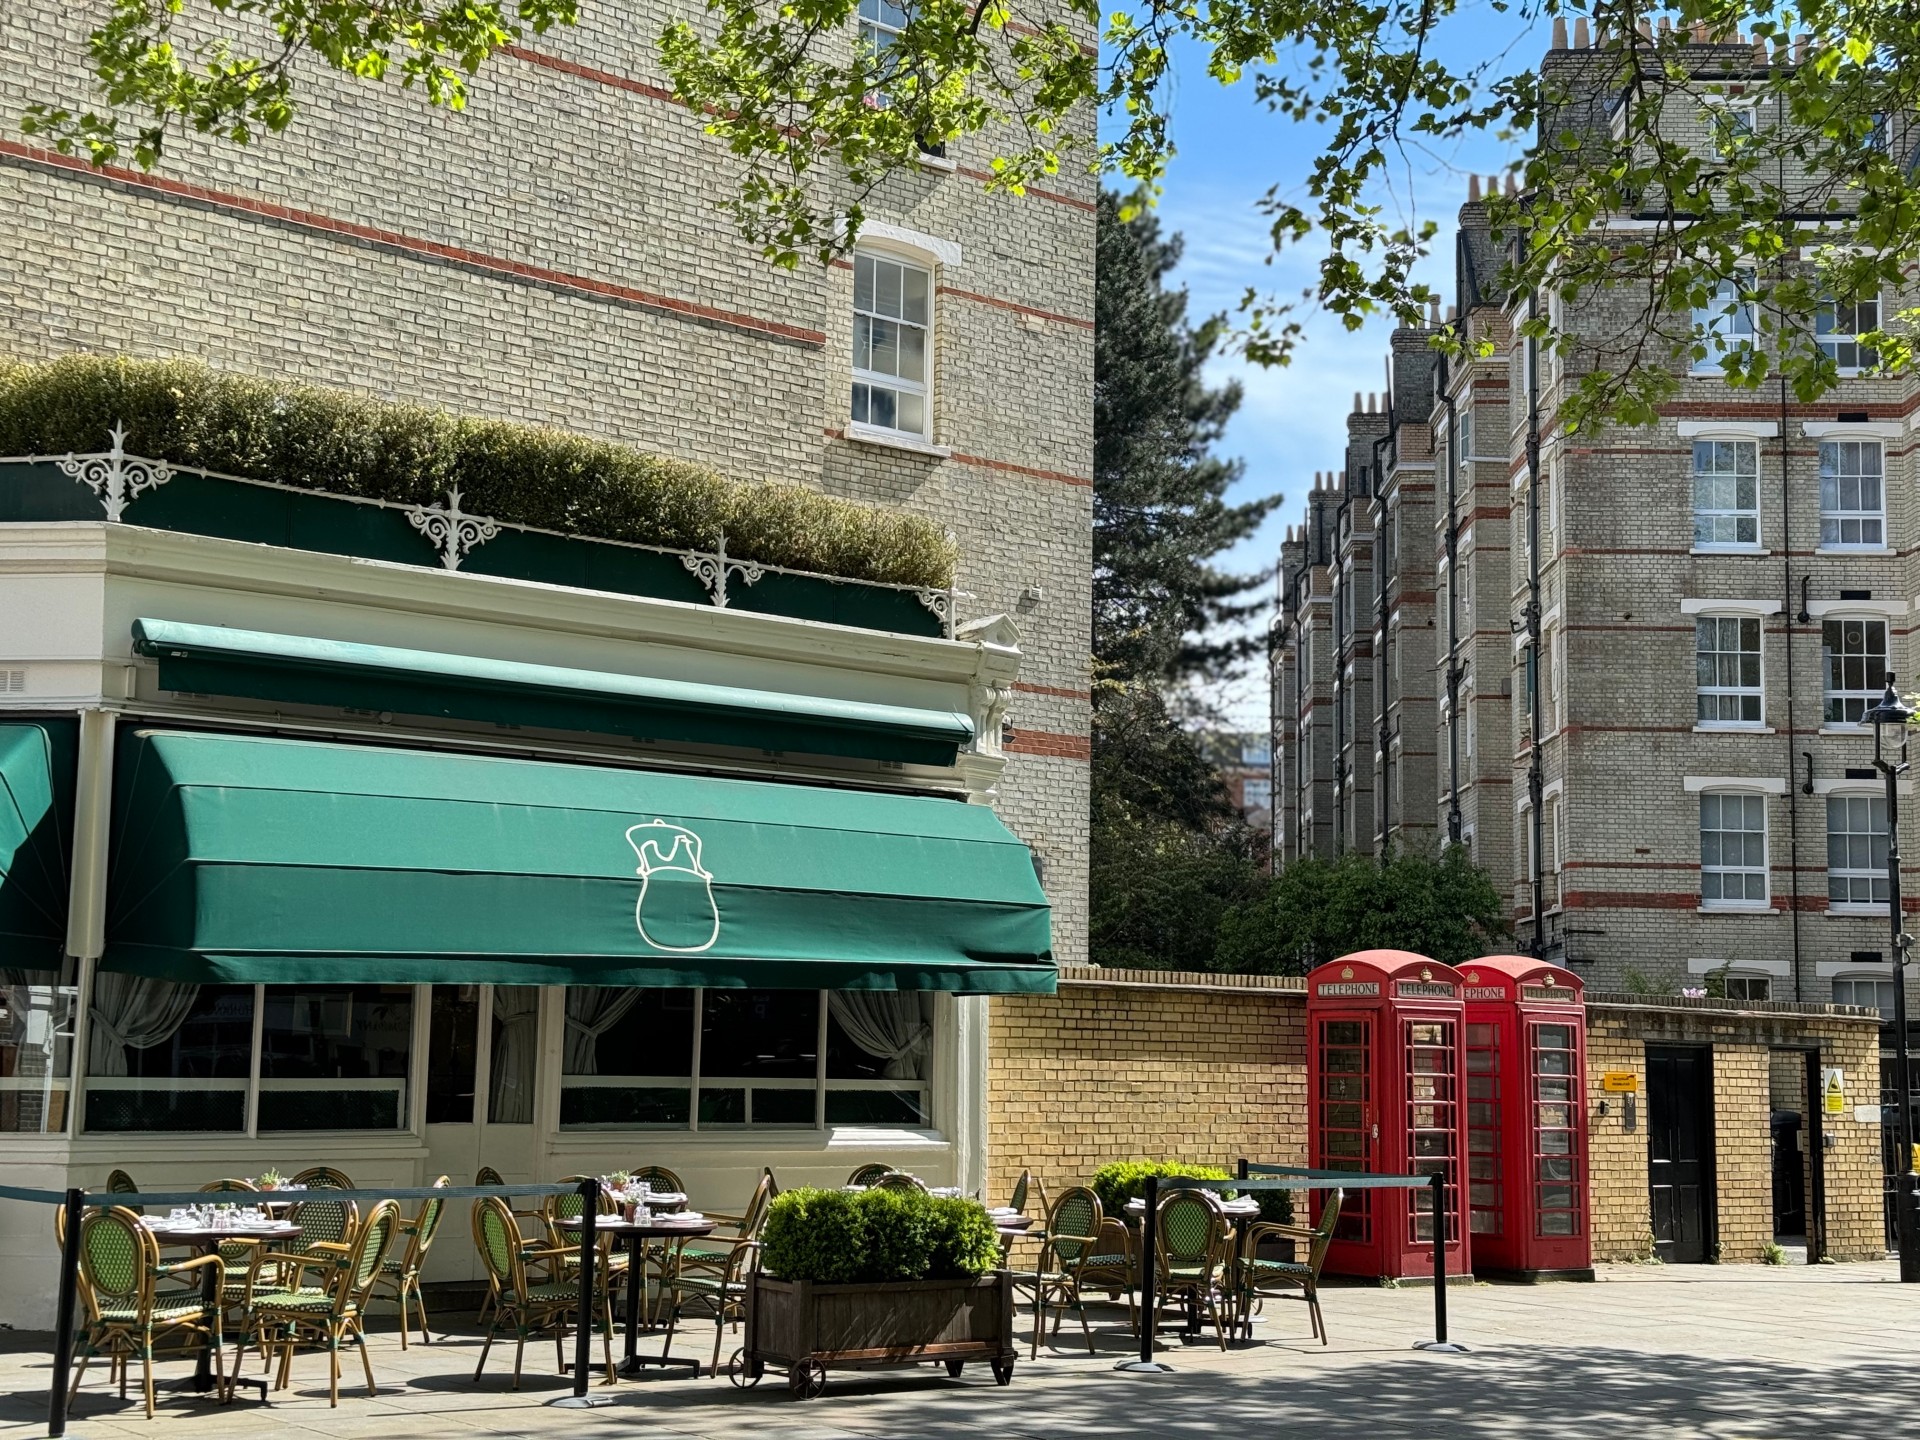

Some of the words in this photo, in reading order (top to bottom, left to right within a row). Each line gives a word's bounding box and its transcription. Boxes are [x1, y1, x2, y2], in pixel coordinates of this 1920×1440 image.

[1321, 983, 1377, 995] TELEPHONE
[1400, 983, 1452, 996] TELEPHONE
[1464, 988, 1504, 999] EPHONE
[1525, 989, 1572, 1000] TELEPHONE
